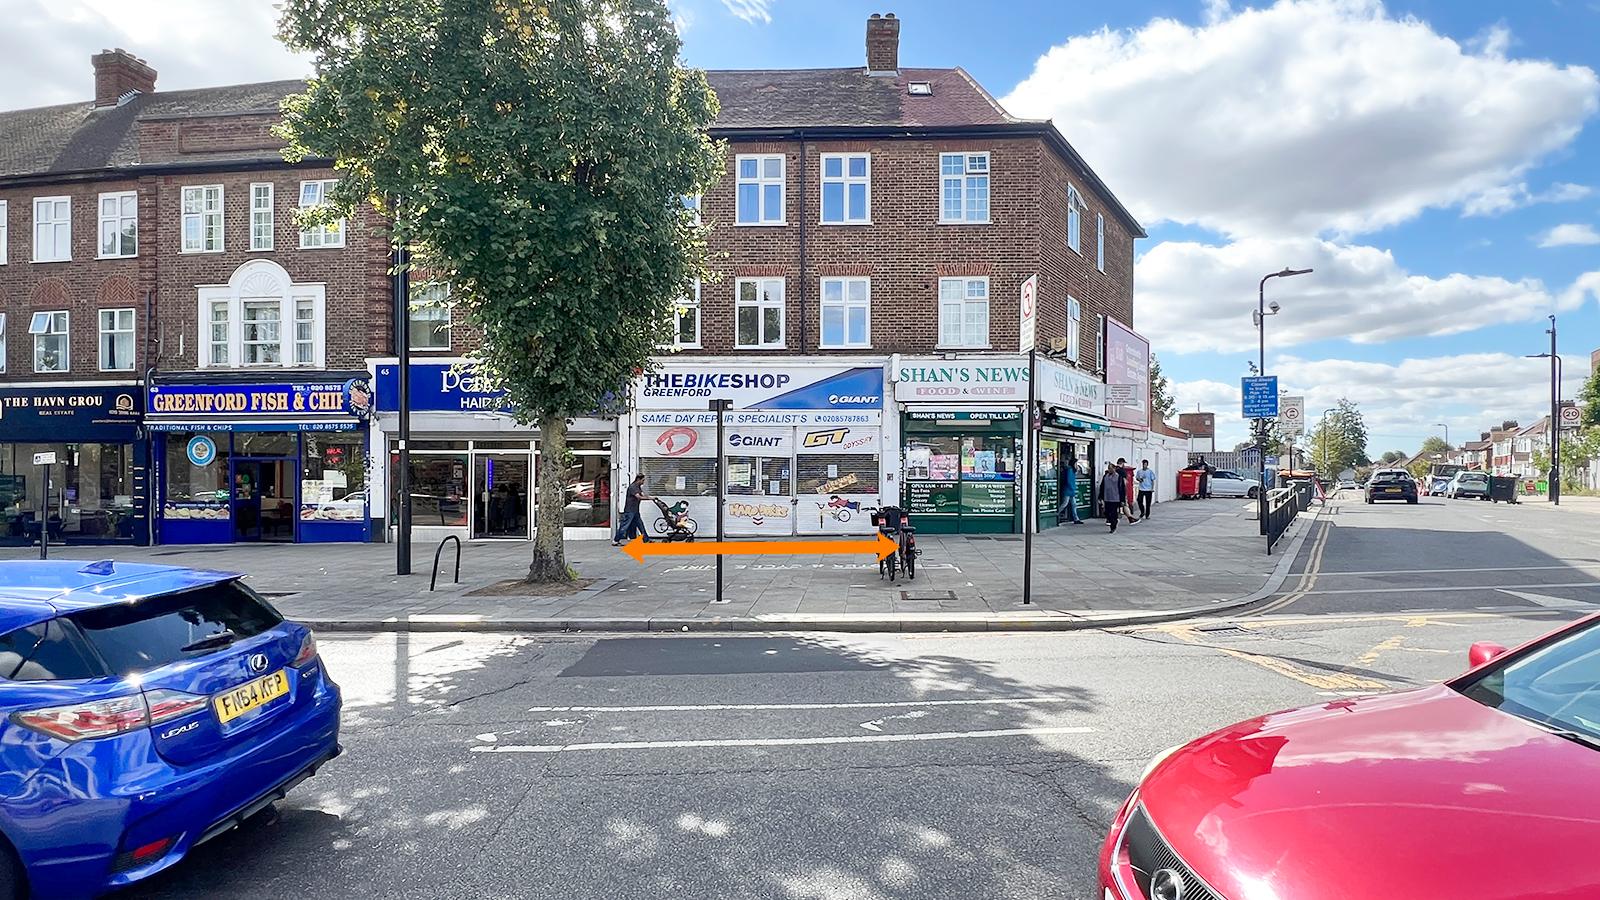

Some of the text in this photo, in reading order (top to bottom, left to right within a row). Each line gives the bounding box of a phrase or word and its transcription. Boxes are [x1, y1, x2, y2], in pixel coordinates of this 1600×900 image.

[381, 368, 390, 376] 65
[900, 367, 1030, 382] SHAN'S NEWS
[643, 388, 712, 397] GREENFORD
[920, 387, 956, 395] FOOD
[976, 386, 1011, 394] WINE
[3, 395, 103, 407] THE HAVN GROU
[153, 393, 248, 412] GREENFORD
[251, 393, 289, 410] FISH
[293, 392, 305, 410] &
[839, 396, 879, 404] GIANT
[641, 414, 672, 423] SAME
[674, 414, 696, 423] DAY
[696, 414, 734, 423] REPIR
[737, 414, 807, 423] SPECIALIST'S
[741, 436, 783, 447] GIANT
[802, 427, 850, 448] GT
[221, 674, 282, 716] FN64 KFP
[161, 721, 199, 739] LEXUS
